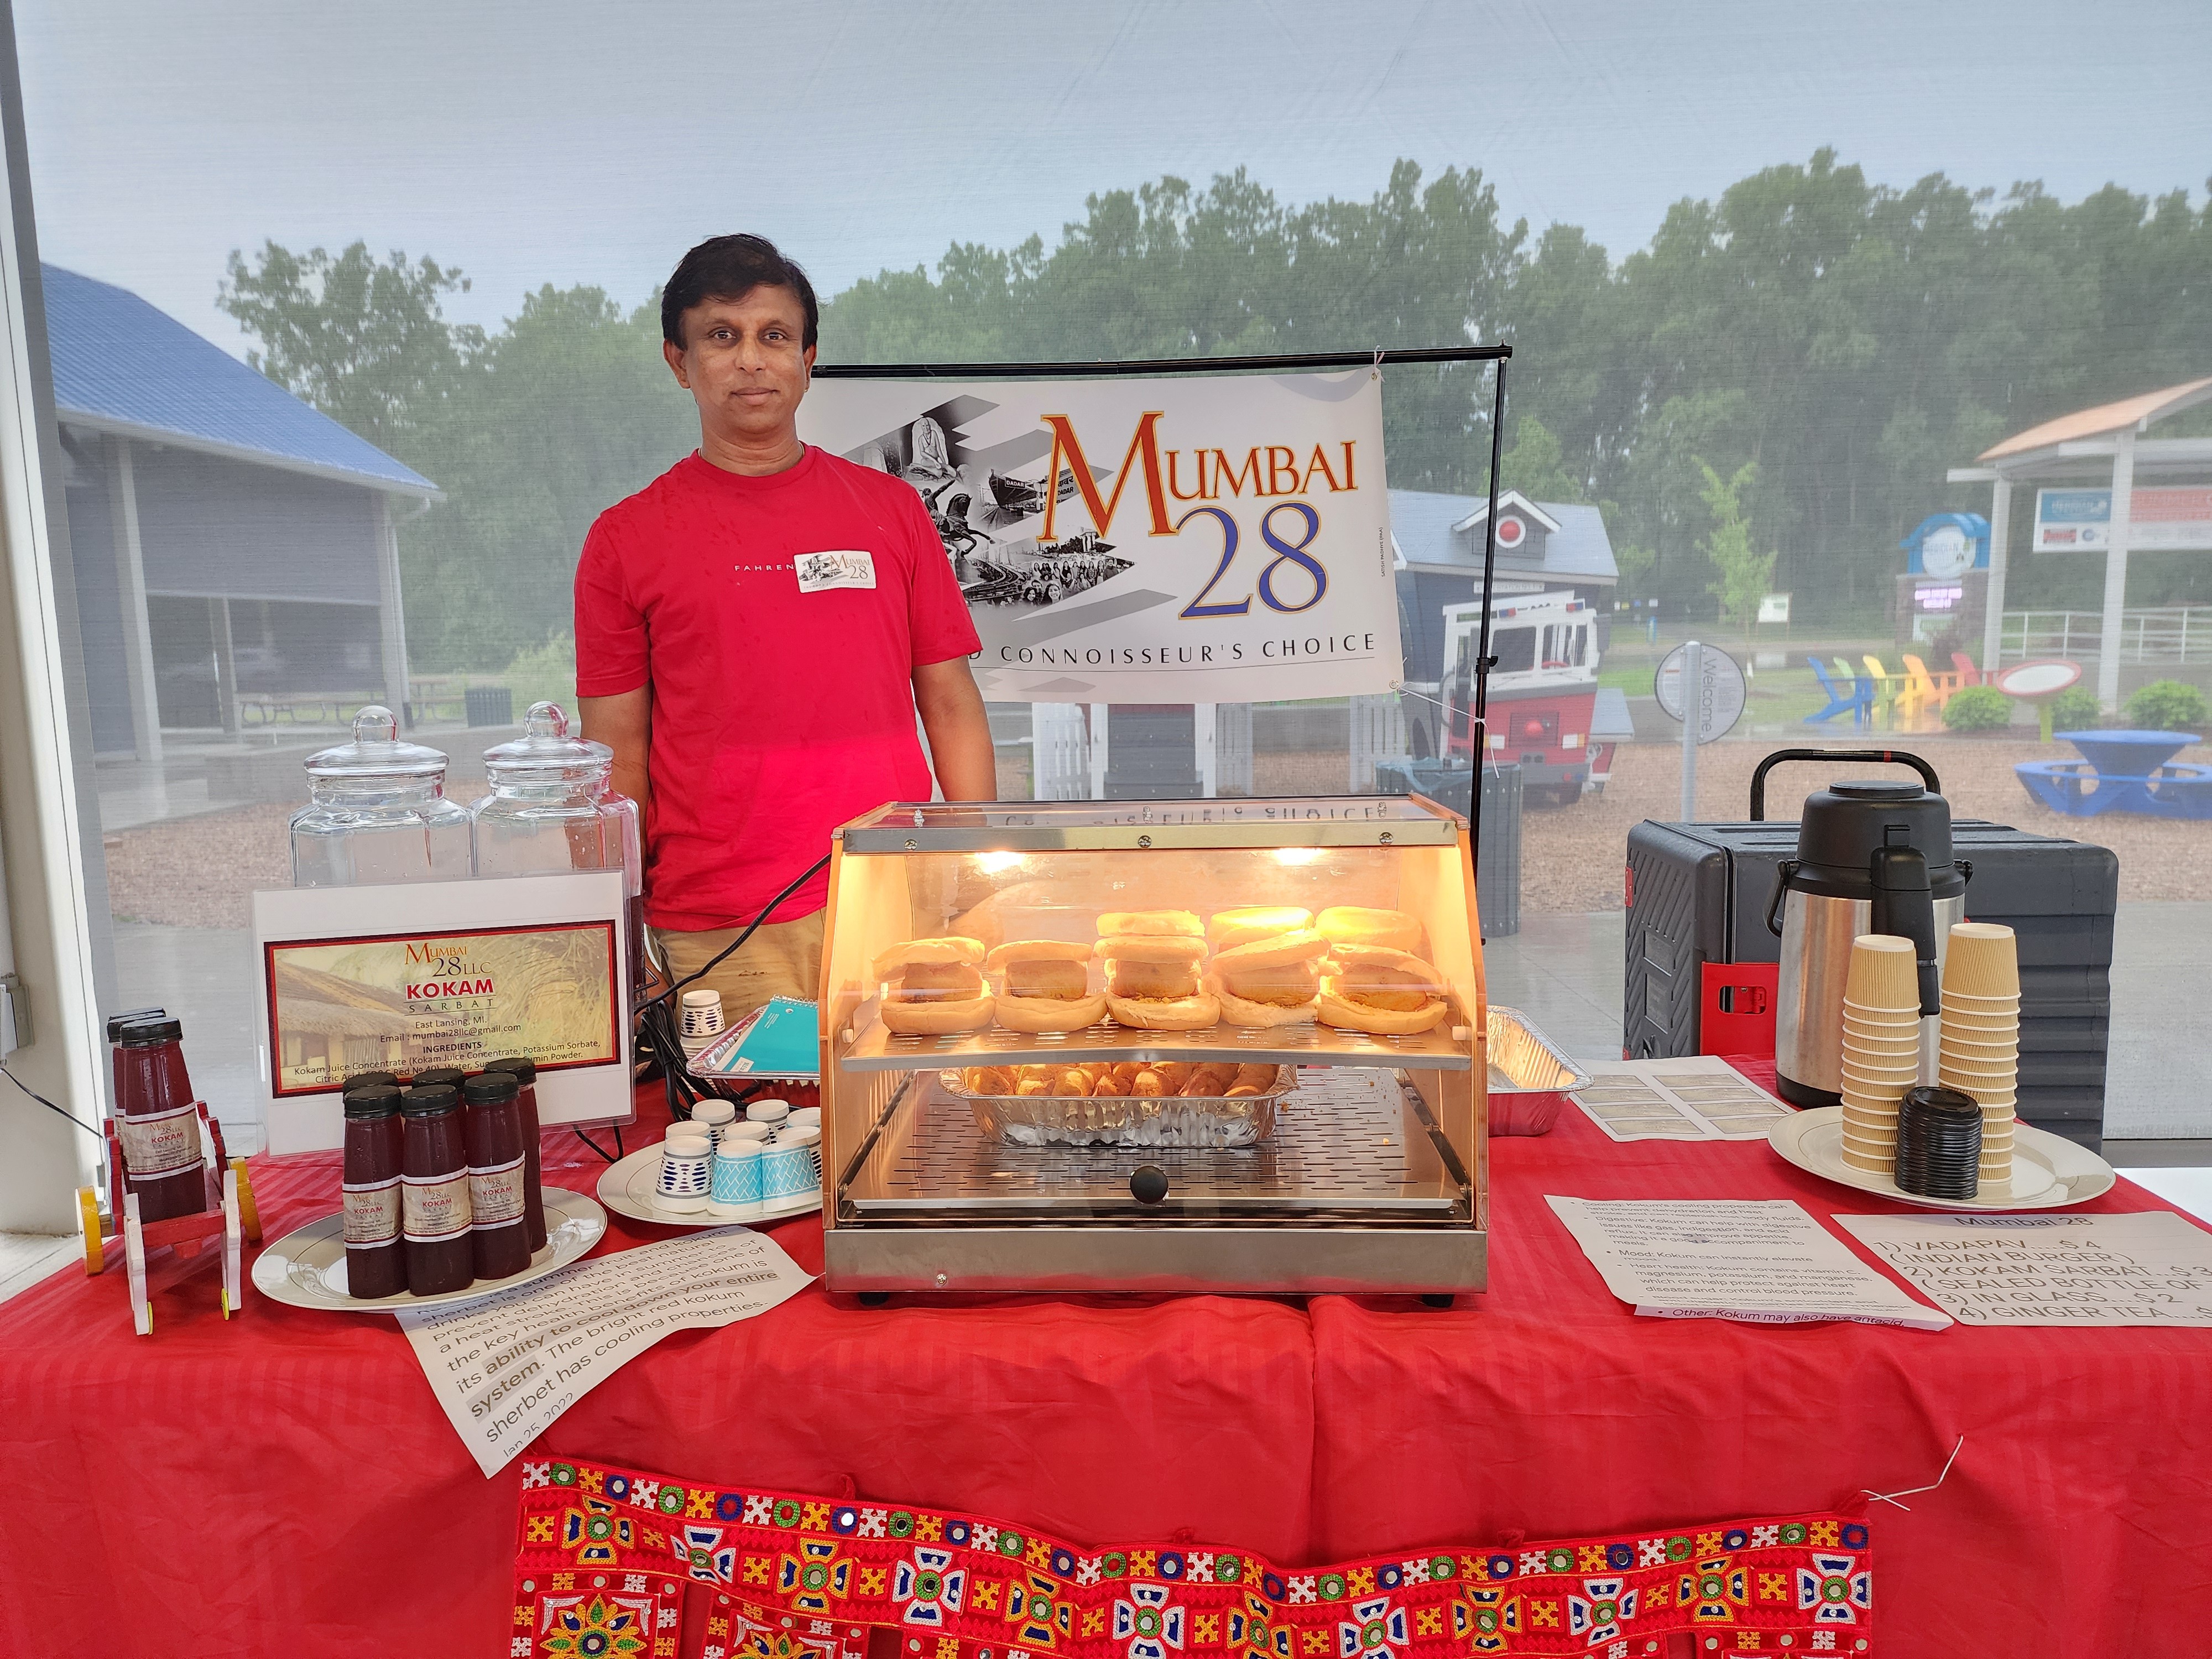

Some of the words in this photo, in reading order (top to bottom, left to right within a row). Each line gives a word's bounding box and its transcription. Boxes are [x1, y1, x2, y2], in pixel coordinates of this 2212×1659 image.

[1057, 487, 1073, 495] DADAR
[1177, 500, 1329, 620] 28
[850, 565, 868, 579] 28
[1000, 643, 1242, 664] CONNOISSEUR'S
[1262, 633, 1375, 658] CHOICE
[1702, 659, 1717, 732] Welcome
[432, 956, 461, 977] 28
[407, 979, 493, 999] KOKAM
[409, 999, 493, 1013] SARBAT
[436, 1018, 470, 1028] Lansing,
[380, 1034, 404, 1043] Email
[413, 1024, 521, 1040] mumbai28llc@gmail.com
[422, 1041, 482, 1054] INGREDIENTS
[294, 1067, 326, 1075] Kokam
[327, 1064, 349, 1073] Juice
[352, 1058, 406, 1070] Concentrate
[409, 1056, 441, 1066] (Kokam
[444, 1053, 465, 1062] Juice
[467, 1048, 520, 1060] Concentrate,
[523, 1043, 565, 1054] Potassium
[567, 1040, 601, 1050] Sorbate,
[393, 1067, 410, 1076] Red
[551, 1051, 583, 1061] Powder.
[152, 1132, 183, 1144] KOKAM
[483, 1186, 512, 1196] KOKAM
[422, 1198, 452, 1207] KOKAM
[1953, 1217, 2057, 1226] Mumbai
[2058, 1217, 2094, 1225] 28
[1618, 1249, 1655, 1258] Mood:
[1873, 1241, 1901, 1253] 1)
[2086, 1240, 2101, 1249] 4
[523, 1264, 594, 1288] summer
[598, 1254, 636, 1266] fruit
[639, 1244, 671, 1255] and
[674, 1229, 728, 1247] kokum
[1903, 1265, 1934, 1278] 2)
[1936, 1264, 2042, 1276] KOKAM
[2192, 1266, 2212, 1276] 3
[421, 1300, 497, 1323] sherbet
[521, 1284, 555, 1297] one
[560, 1276, 578, 1285] of
[582, 1269, 612, 1279] the
[615, 1256, 653, 1270] best
[658, 1240, 716, 1258] natural
[427, 1311, 487, 1330] drinks
[491, 1302, 527, 1312] you
[532, 1290, 566, 1302] can
[568, 1277, 612, 1292] have
[635, 1249, 705, 1272] summer
[1777, 1281, 1821, 1289] against
[2049, 1277, 2166, 1290] BOTTLE
[2166, 1280, 2204, 1290] OF
[433, 1313, 510, 1342] prevent
[514, 1281, 626, 1315] dehydration
[629, 1270, 661, 1281] and
[666, 1246, 737, 1271] chances
[740, 1239, 757, 1248] of
[1936, 1293, 1969, 1306] 3)
[1970, 1292, 2007, 1303] IN
[2157, 1293, 2184, 1303] 2
[440, 1344, 452, 1353] a
[455, 1324, 502, 1345] heat
[505, 1307, 572, 1326] stroke.
[573, 1294, 613, 1307] This
[635, 1262, 709, 1289] because
[713, 1252, 745, 1264] one
[748, 1246, 766, 1255] of
[447, 1349, 481, 1372] the
[483, 1329, 519, 1350] key
[523, 1309, 586, 1332] health
[588, 1284, 666, 1311] benefits
[669, 1276, 687, 1286] of
[690, 1261, 750, 1279] kokum
[752, 1259, 768, 1267] is
[1716, 1309, 1760, 1321] Kokum
[1763, 1313, 1791, 1324] may
[1959, 1306, 1987, 1321] 4)
[1991, 1305, 2109, 1318] GINGER
[455, 1372, 482, 1394] its
[486, 1334, 545, 1375] ability
[549, 1324, 572, 1335] to
[576, 1308, 619, 1326] cool
[624, 1291, 677, 1311] down
[679, 1280, 722, 1294] your
[726, 1271, 779, 1285] entire
[471, 1359, 545, 1417] system.
[545, 1335, 583, 1359] The
[586, 1311, 646, 1338] bright
[649, 1299, 682, 1314] red
[684, 1290, 746, 1305] kokum
[487, 1378, 556, 1442] sherbet
[556, 1354, 592, 1383] has
[594, 1317, 665, 1357] cooling
[667, 1301, 769, 1322] properties.
